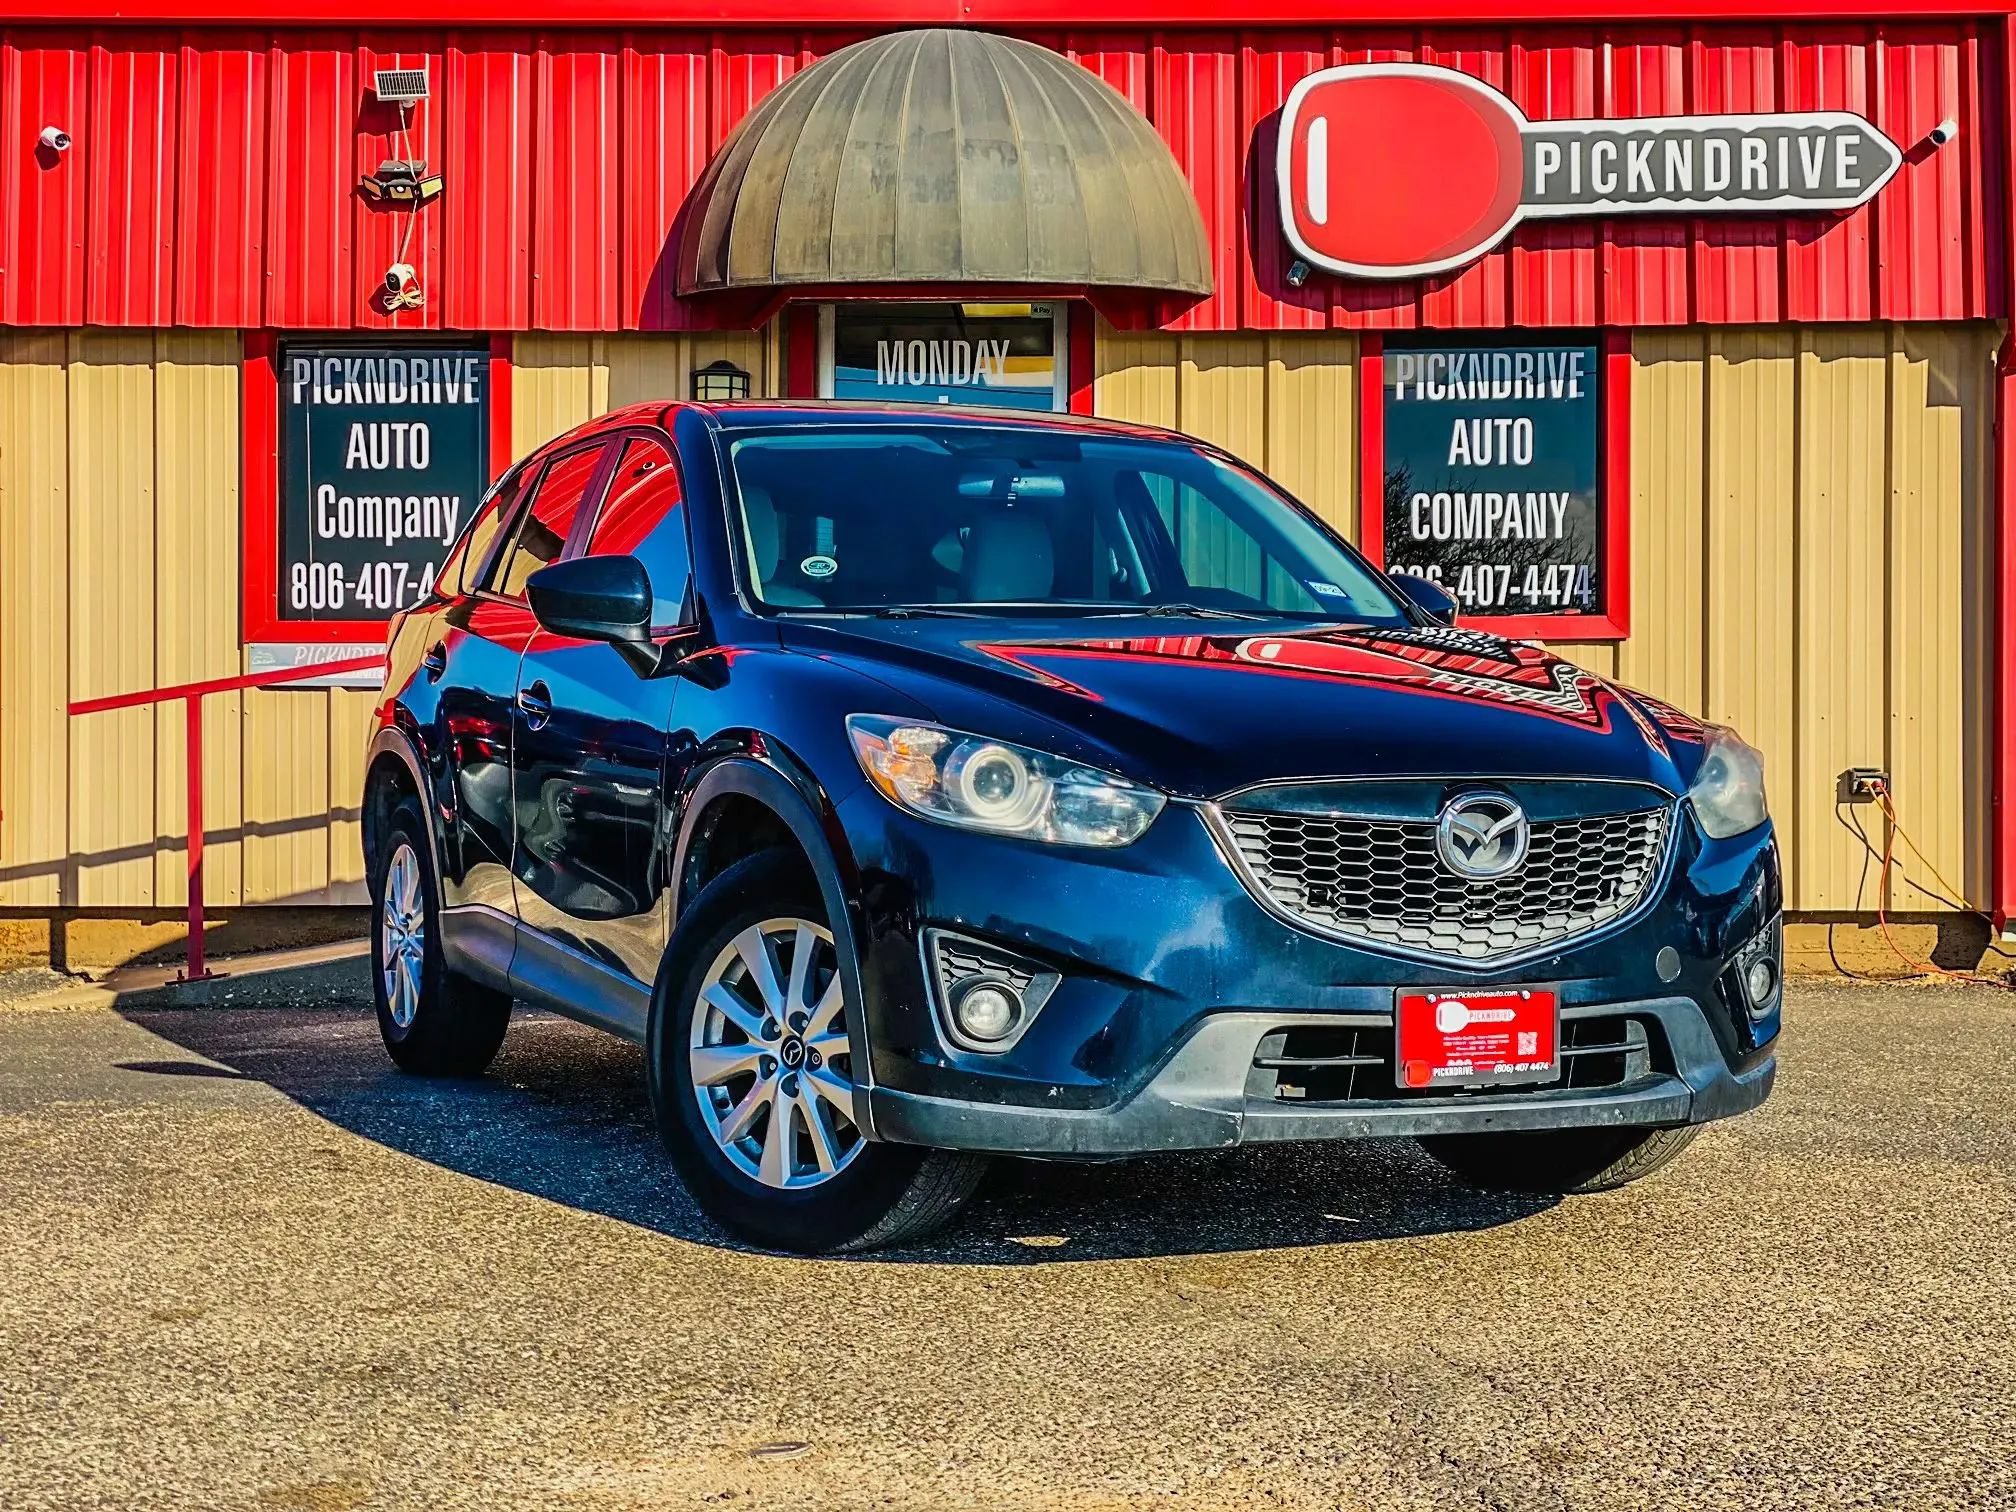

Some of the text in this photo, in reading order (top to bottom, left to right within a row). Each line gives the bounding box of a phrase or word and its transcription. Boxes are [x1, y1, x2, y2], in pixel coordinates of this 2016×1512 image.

[1534, 134, 1861, 196] PICKNDRIVE
[293, 357, 480, 405] PICKNDRIVE
[876, 339, 1010, 386] MONDAY
[1395, 351, 1585, 401] PICKNDRIVE
[345, 422, 431, 470] AUTO
[1447, 417, 1534, 467] AUTO
[317, 483, 460, 547] Company
[1410, 492, 1570, 540] COMPANY
[1388, 563, 1592, 607] -407-4474
[1432, 1065, 1474, 1077] PICKNDRIVE
[1494, 1063, 1514, 1075] (806)
[1515, 1062, 1529, 1072] 407
[1530, 1062, 1549, 1071] 4474
